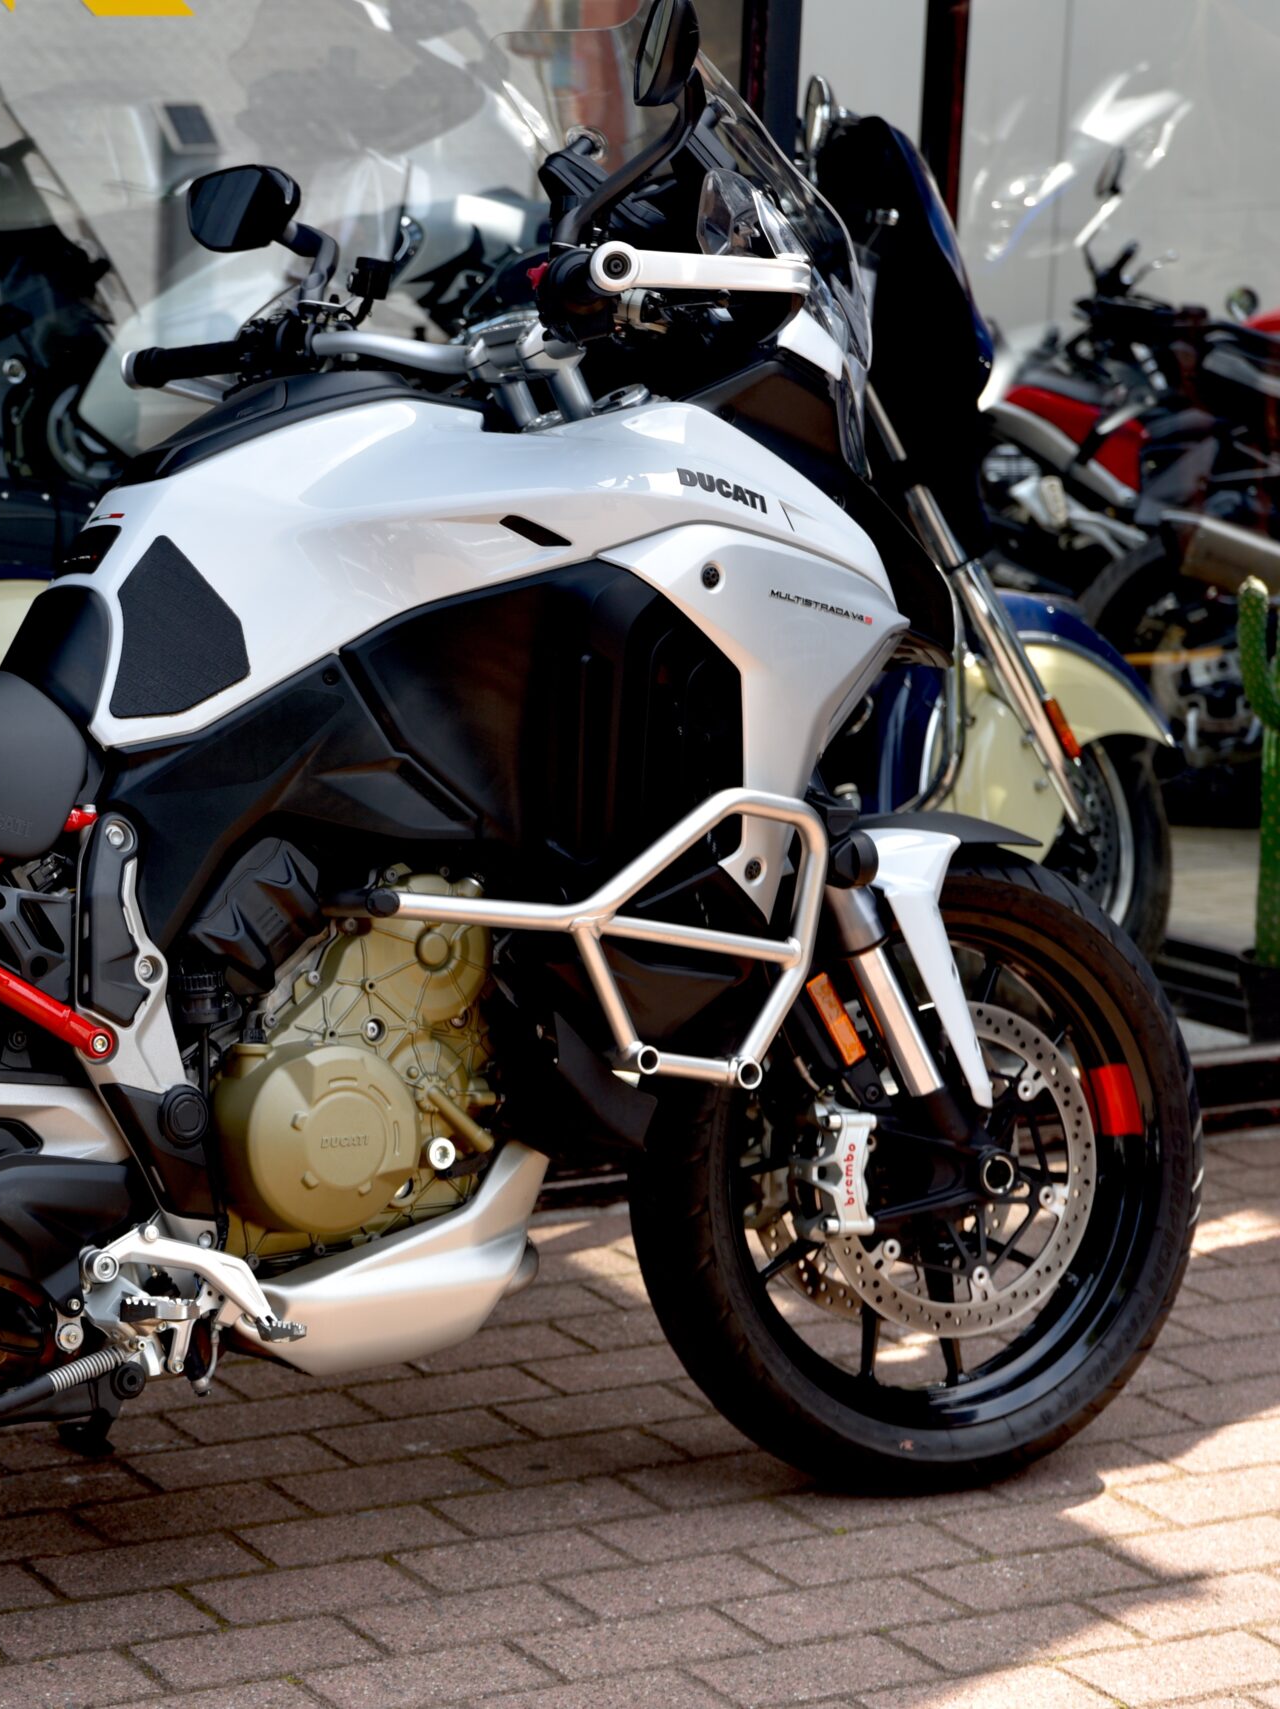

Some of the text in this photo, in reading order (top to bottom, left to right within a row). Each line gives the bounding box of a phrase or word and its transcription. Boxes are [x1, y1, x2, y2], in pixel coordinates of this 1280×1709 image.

[677, 468, 768, 514] DUCATI
[769, 588, 850, 618] MULTISTRADA
[320, 1134, 369, 1149] DUCATI
[843, 1143, 856, 1207] brembo
